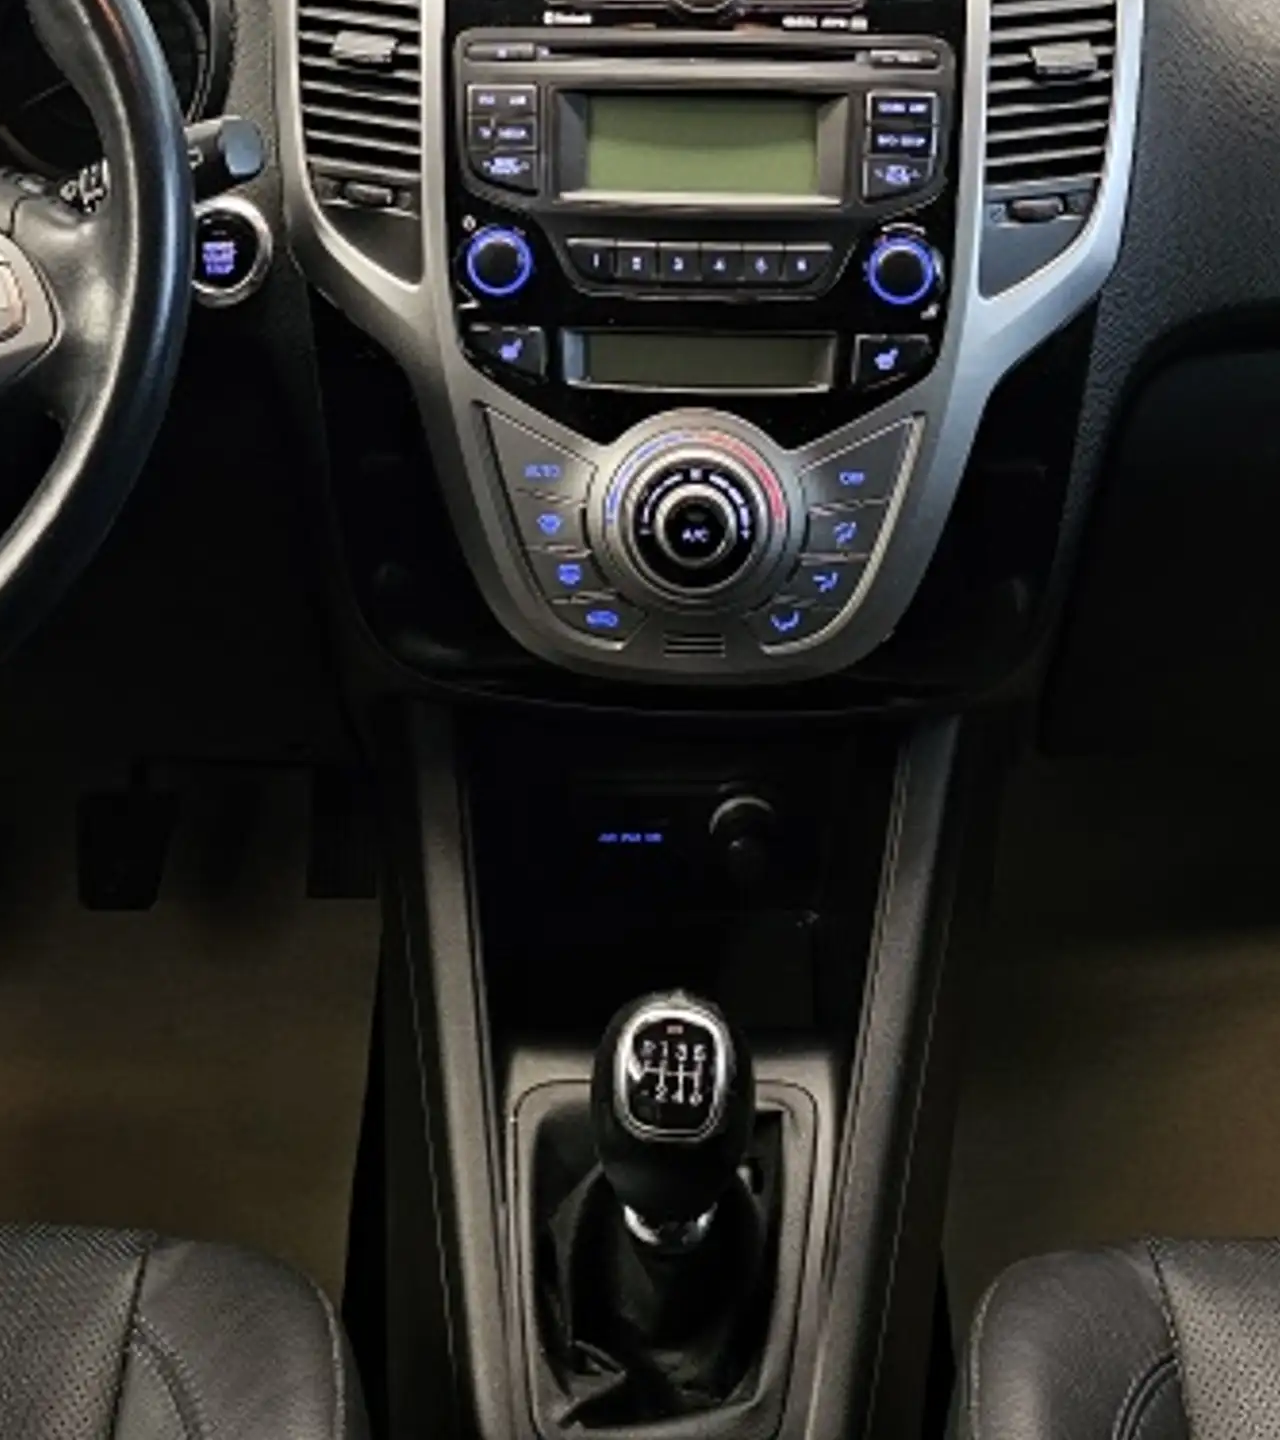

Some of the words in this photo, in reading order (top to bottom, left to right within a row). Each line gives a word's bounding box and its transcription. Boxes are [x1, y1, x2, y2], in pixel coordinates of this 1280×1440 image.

[593, 253, 600, 268] 1
[674, 256, 685, 272] 3
[660, 1040, 669, 1058] 1
[675, 1043, 689, 1062] 3
[654, 1085, 669, 1104] 2
